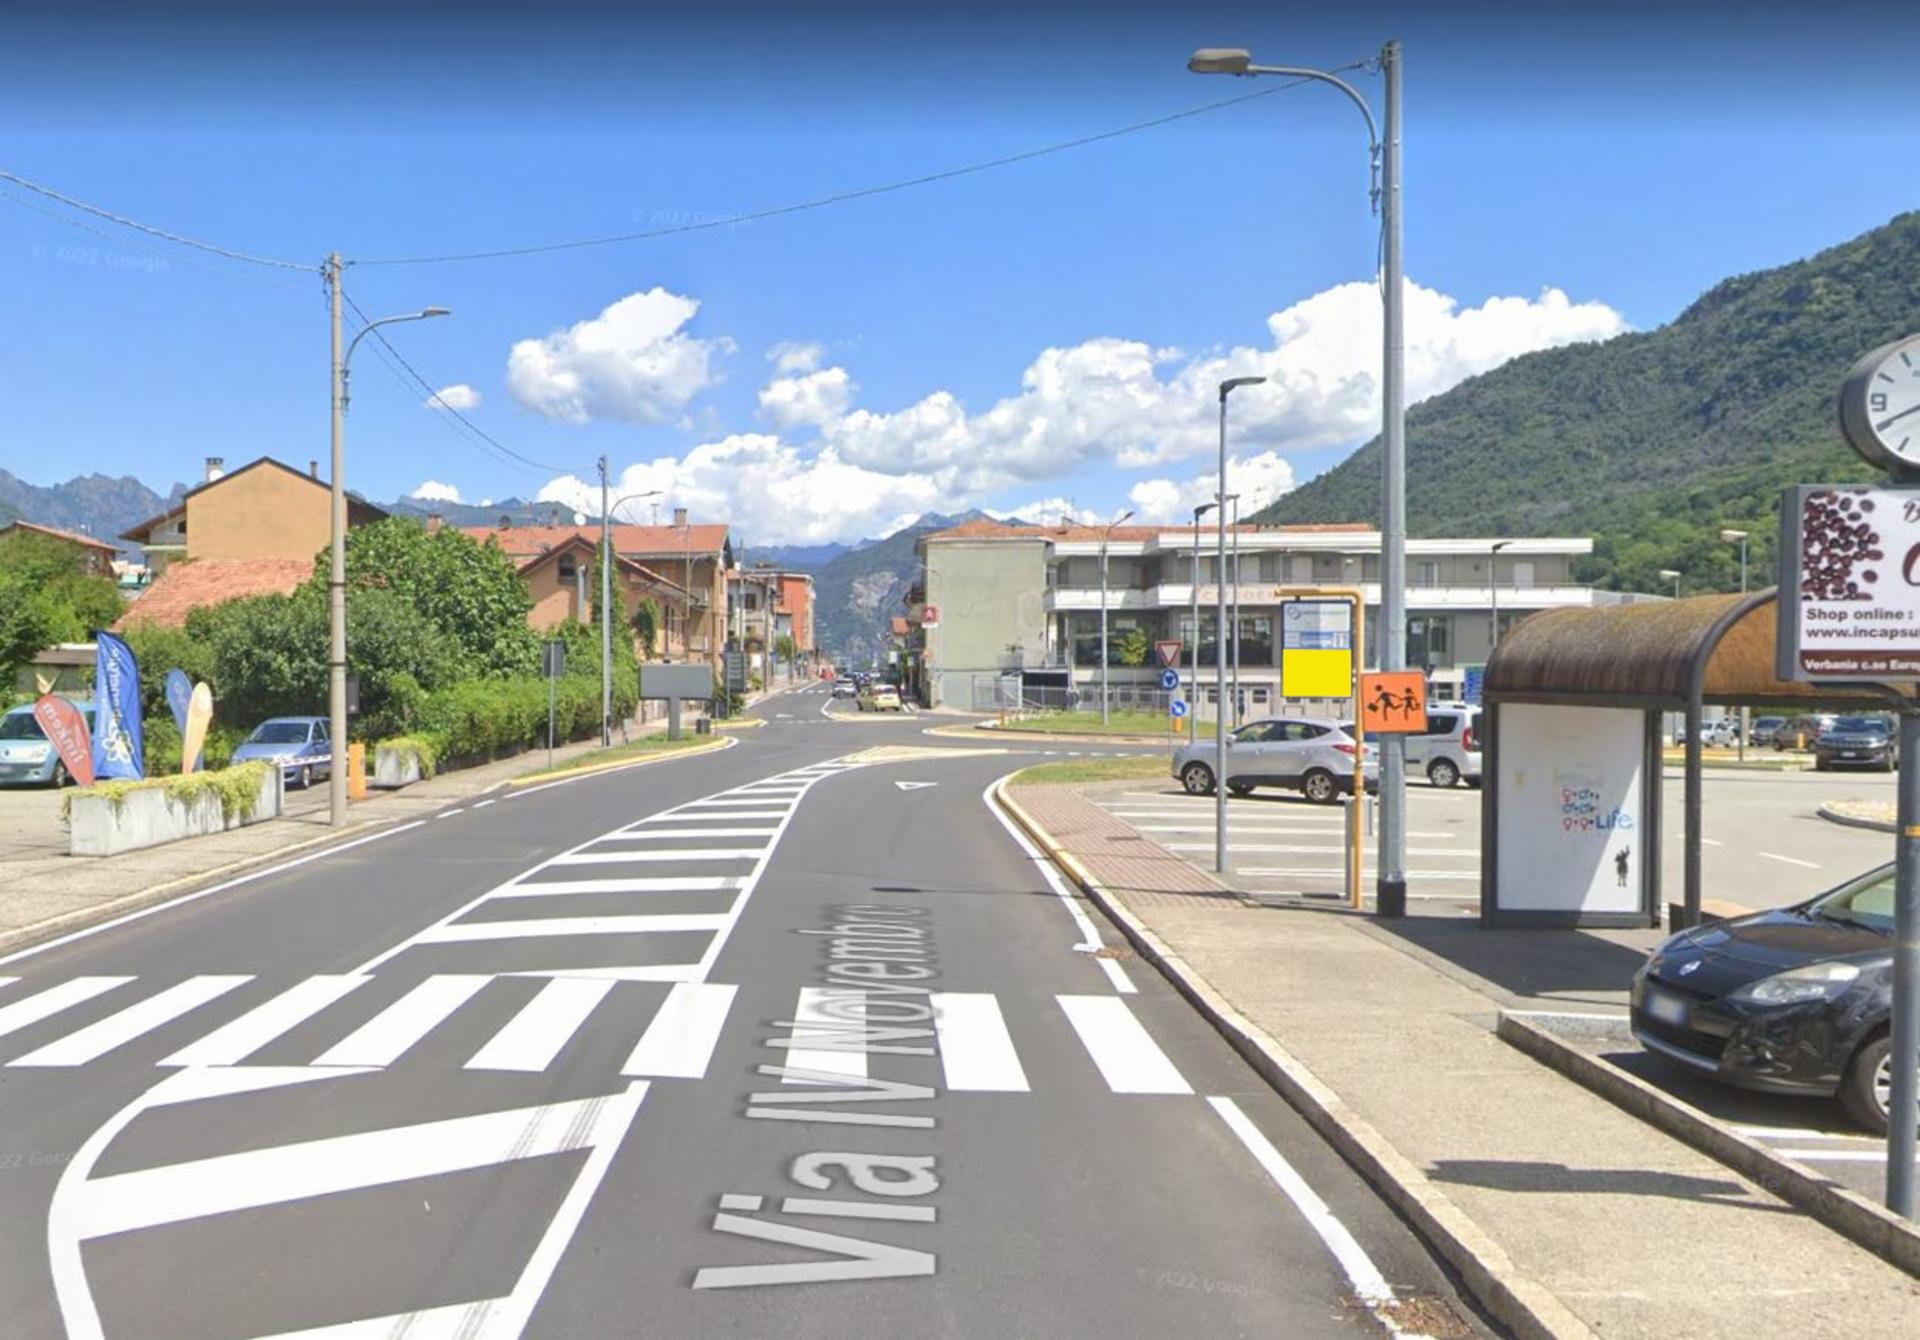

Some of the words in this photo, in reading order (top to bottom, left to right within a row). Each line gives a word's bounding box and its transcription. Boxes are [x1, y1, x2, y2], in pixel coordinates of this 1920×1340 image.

[1870, 393, 1887, 412] 9
[1807, 608, 1848, 621] Shop
[1853, 607, 1904, 620] online
[1805, 659, 1858, 671] Verbania
[1596, 805, 1633, 830] Life
